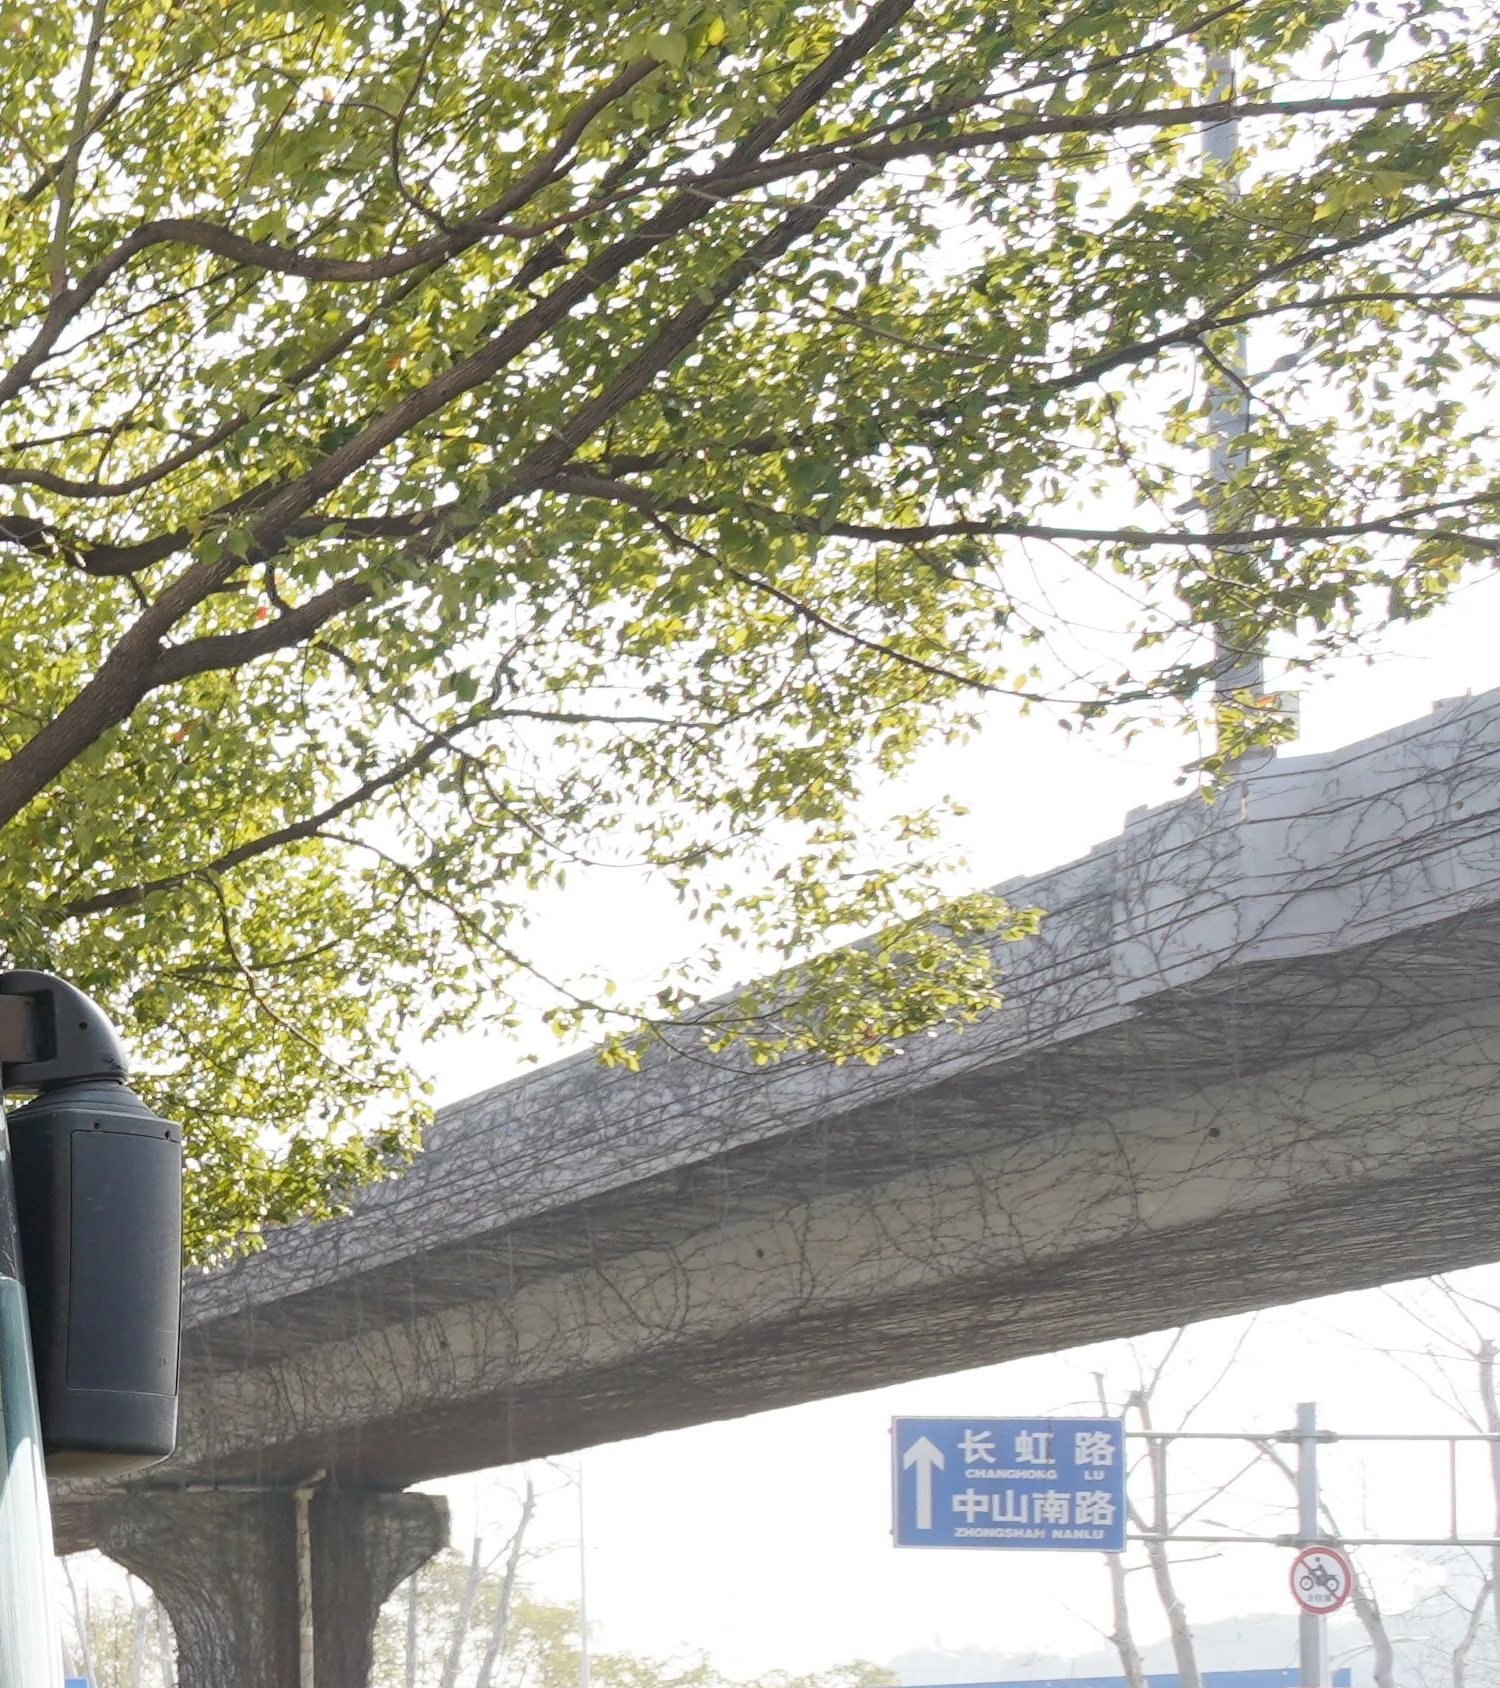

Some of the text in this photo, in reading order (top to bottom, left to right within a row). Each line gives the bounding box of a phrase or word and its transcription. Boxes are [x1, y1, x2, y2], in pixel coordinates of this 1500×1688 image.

[957, 1428, 1117, 1467] 长虹路
[965, 1468, 1105, 1481] CHANGHONG LU
[952, 1487, 1117, 1526] 中山南路
[954, 1527, 1045, 1539] ZHONGSHAN
